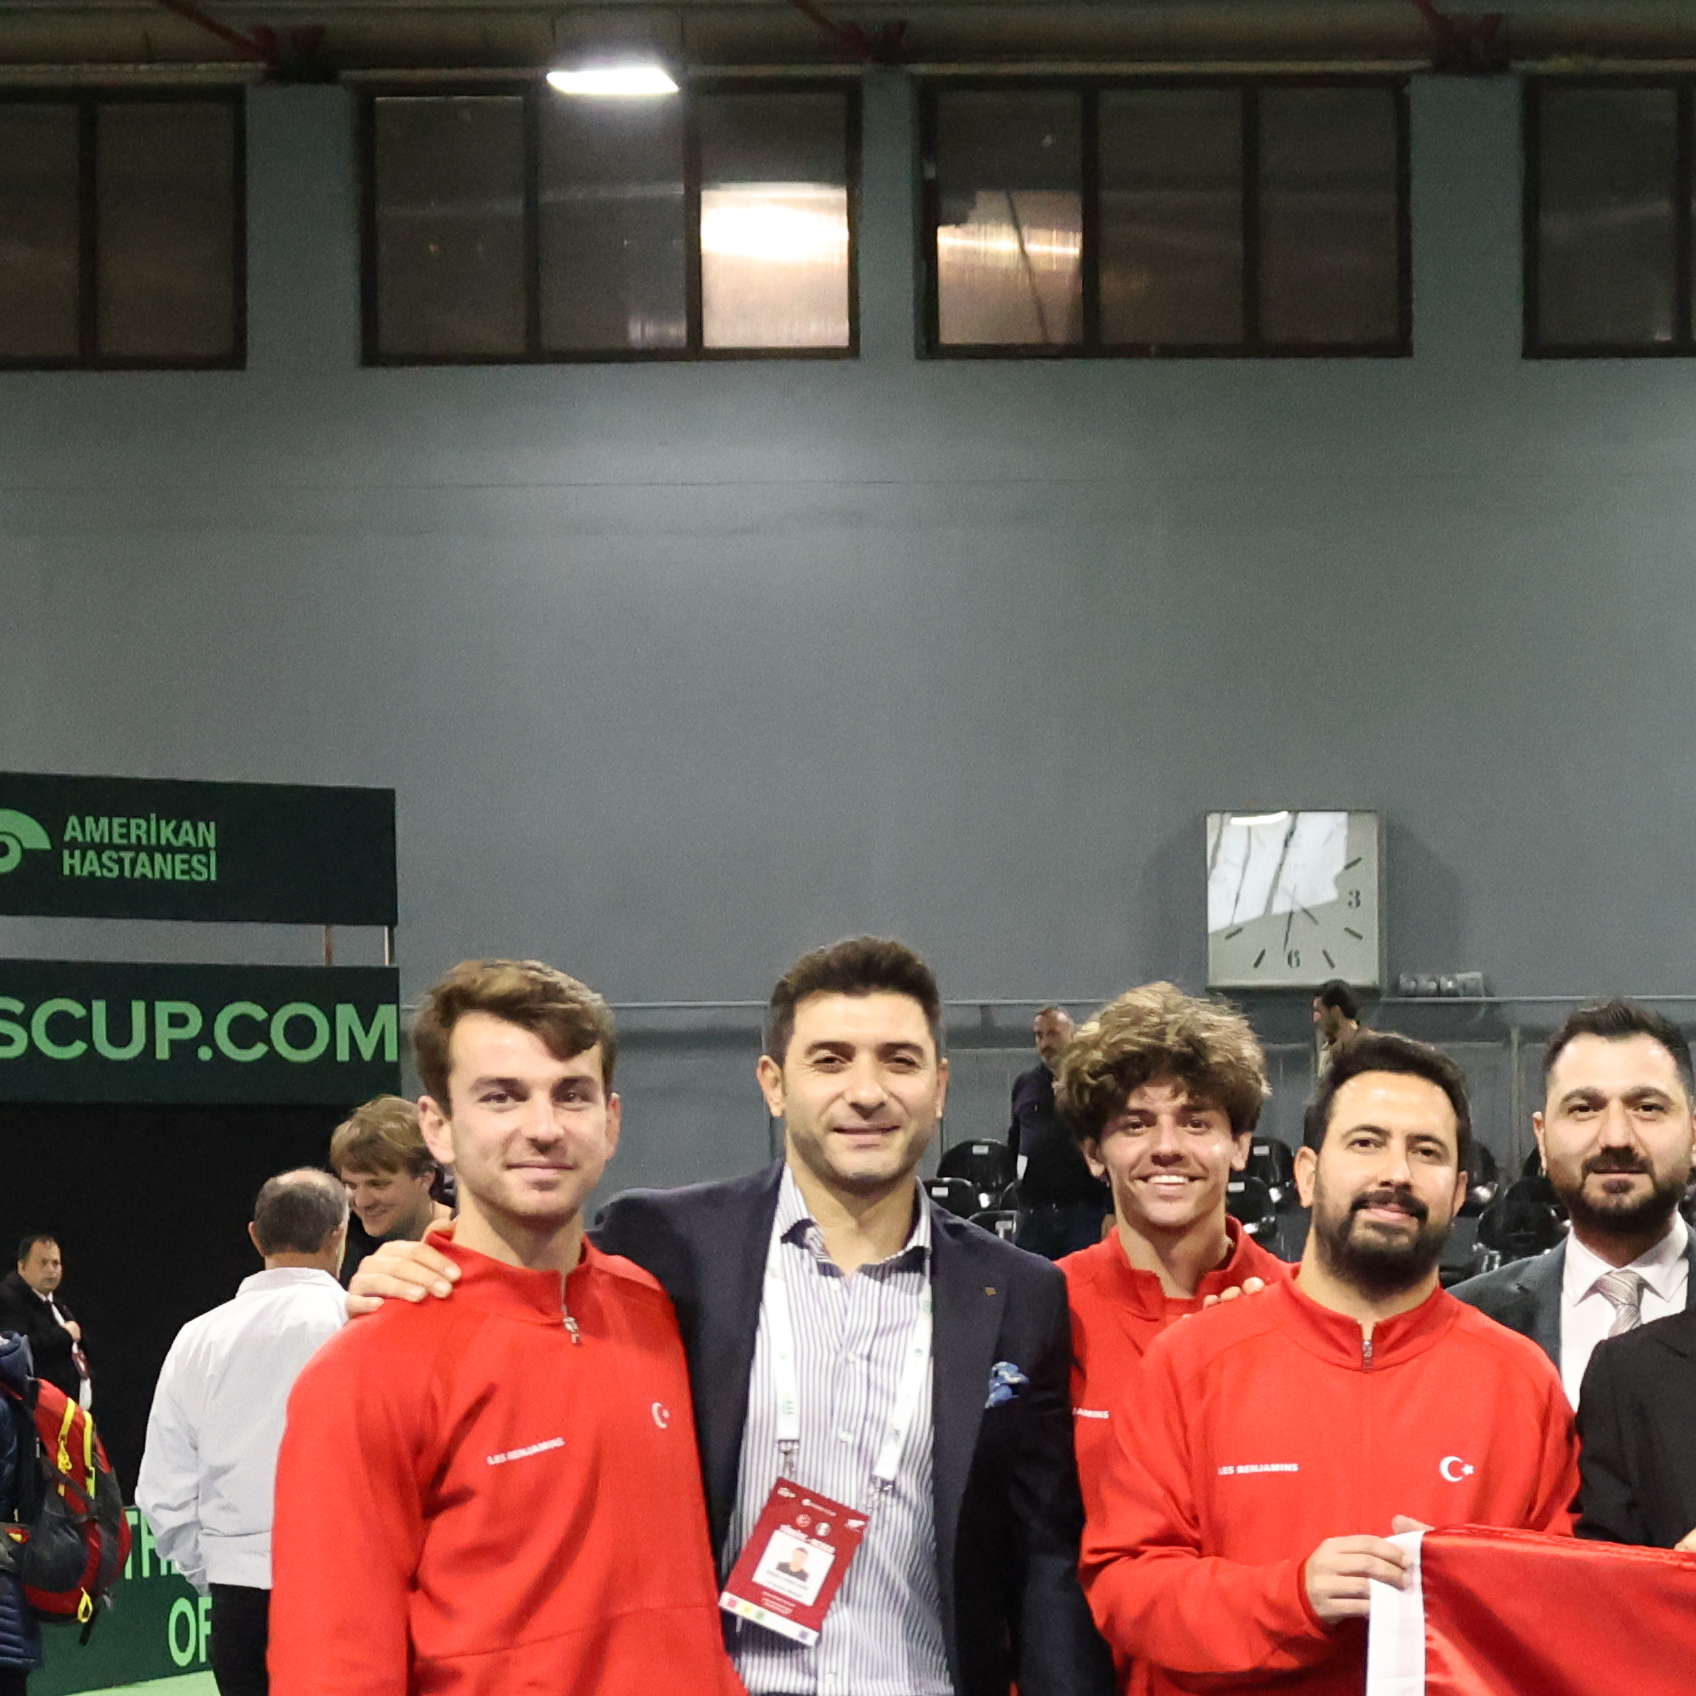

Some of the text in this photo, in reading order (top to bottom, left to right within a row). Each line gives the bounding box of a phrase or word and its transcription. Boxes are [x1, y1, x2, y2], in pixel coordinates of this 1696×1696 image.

[63, 812, 217, 848] AMERİKAN
[62, 848, 217, 882] HASTANESİ
[1347, 888, 1361, 909] 3
[1287, 948, 1301, 969] 6
[1217, 1463, 1300, 1476] LES BENJAMINS
